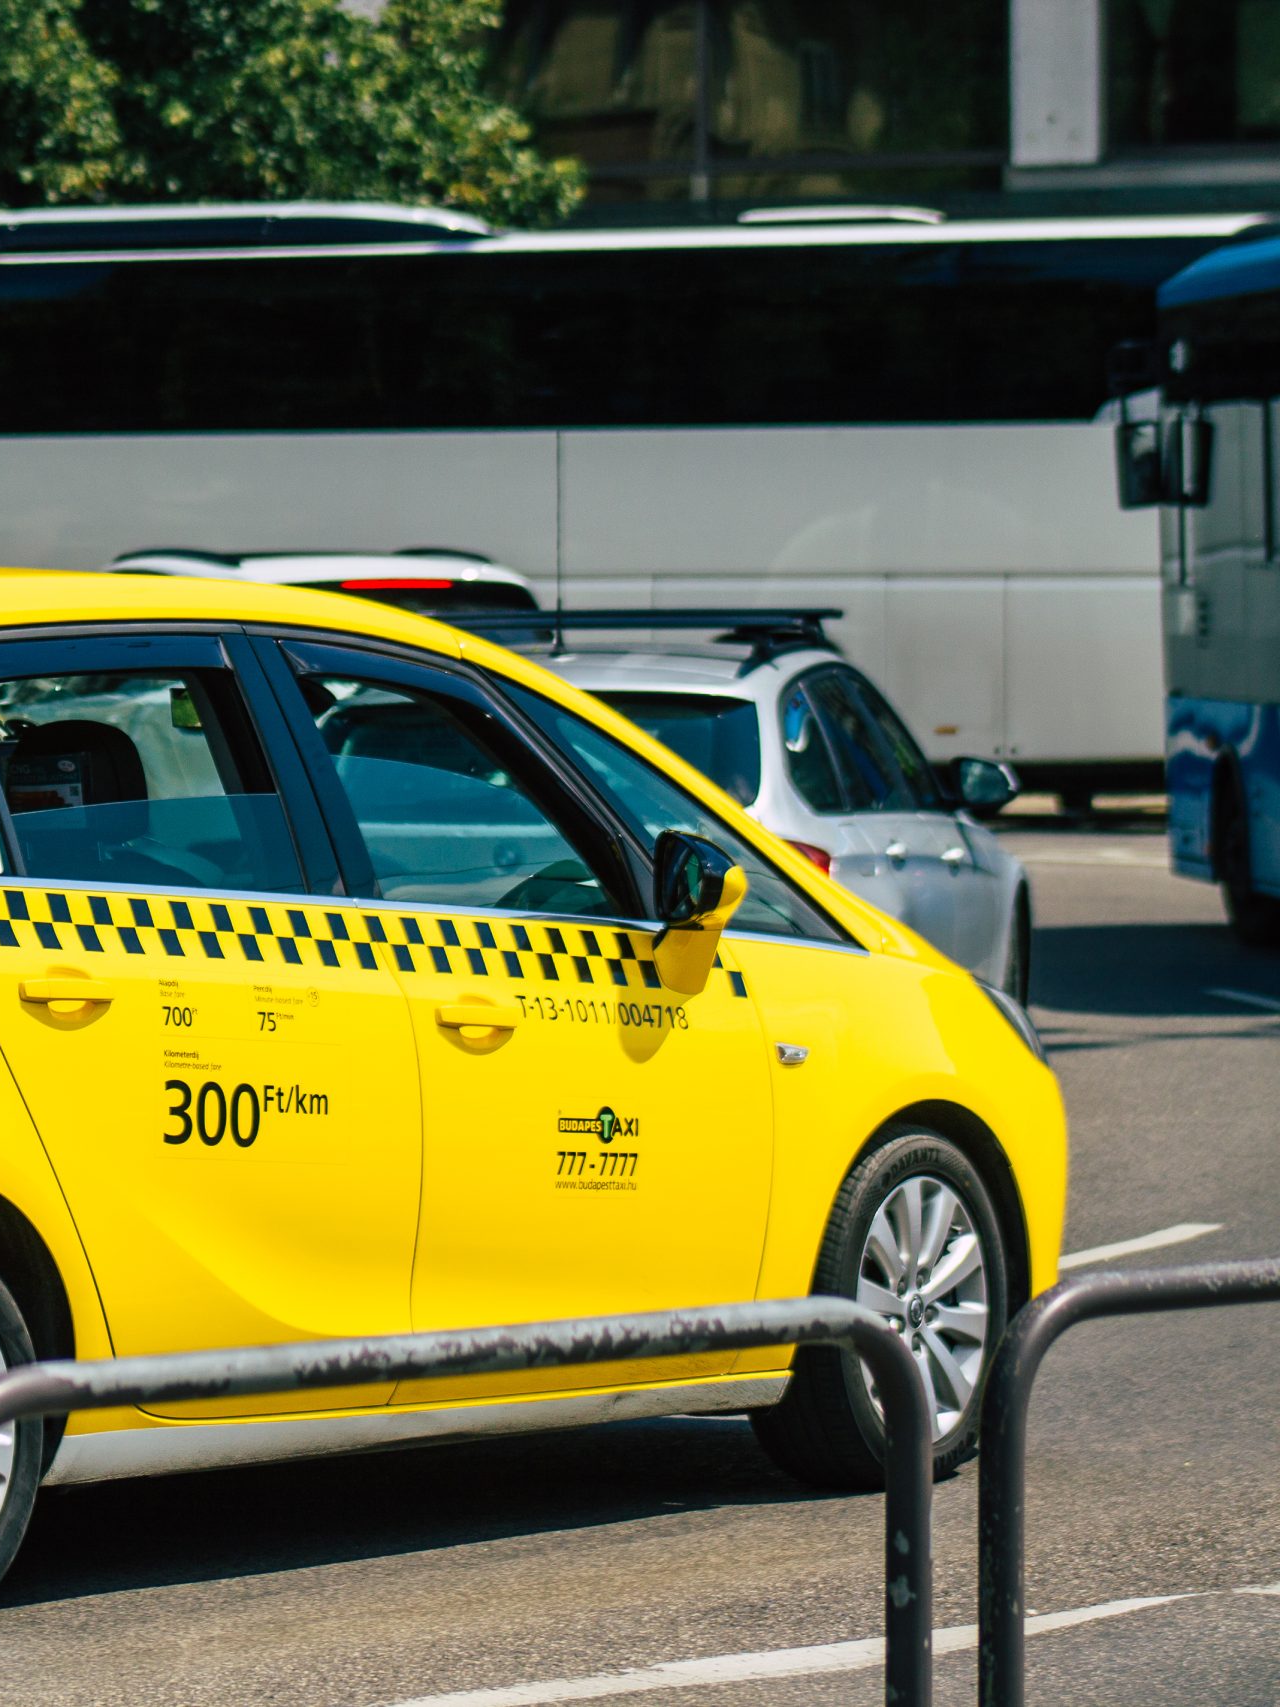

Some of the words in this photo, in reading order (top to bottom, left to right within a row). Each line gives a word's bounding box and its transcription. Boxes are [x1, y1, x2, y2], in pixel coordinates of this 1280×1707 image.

[162, 1006, 192, 1027] 700
[257, 1012, 276, 1032] 75
[515, 995, 689, 1030] T-13-1011/004718
[163, 1079, 260, 1148] 300
[263, 1084, 329, 1116] Ft/km
[555, 1178, 637, 1192] www.budapesttaxi.hu
